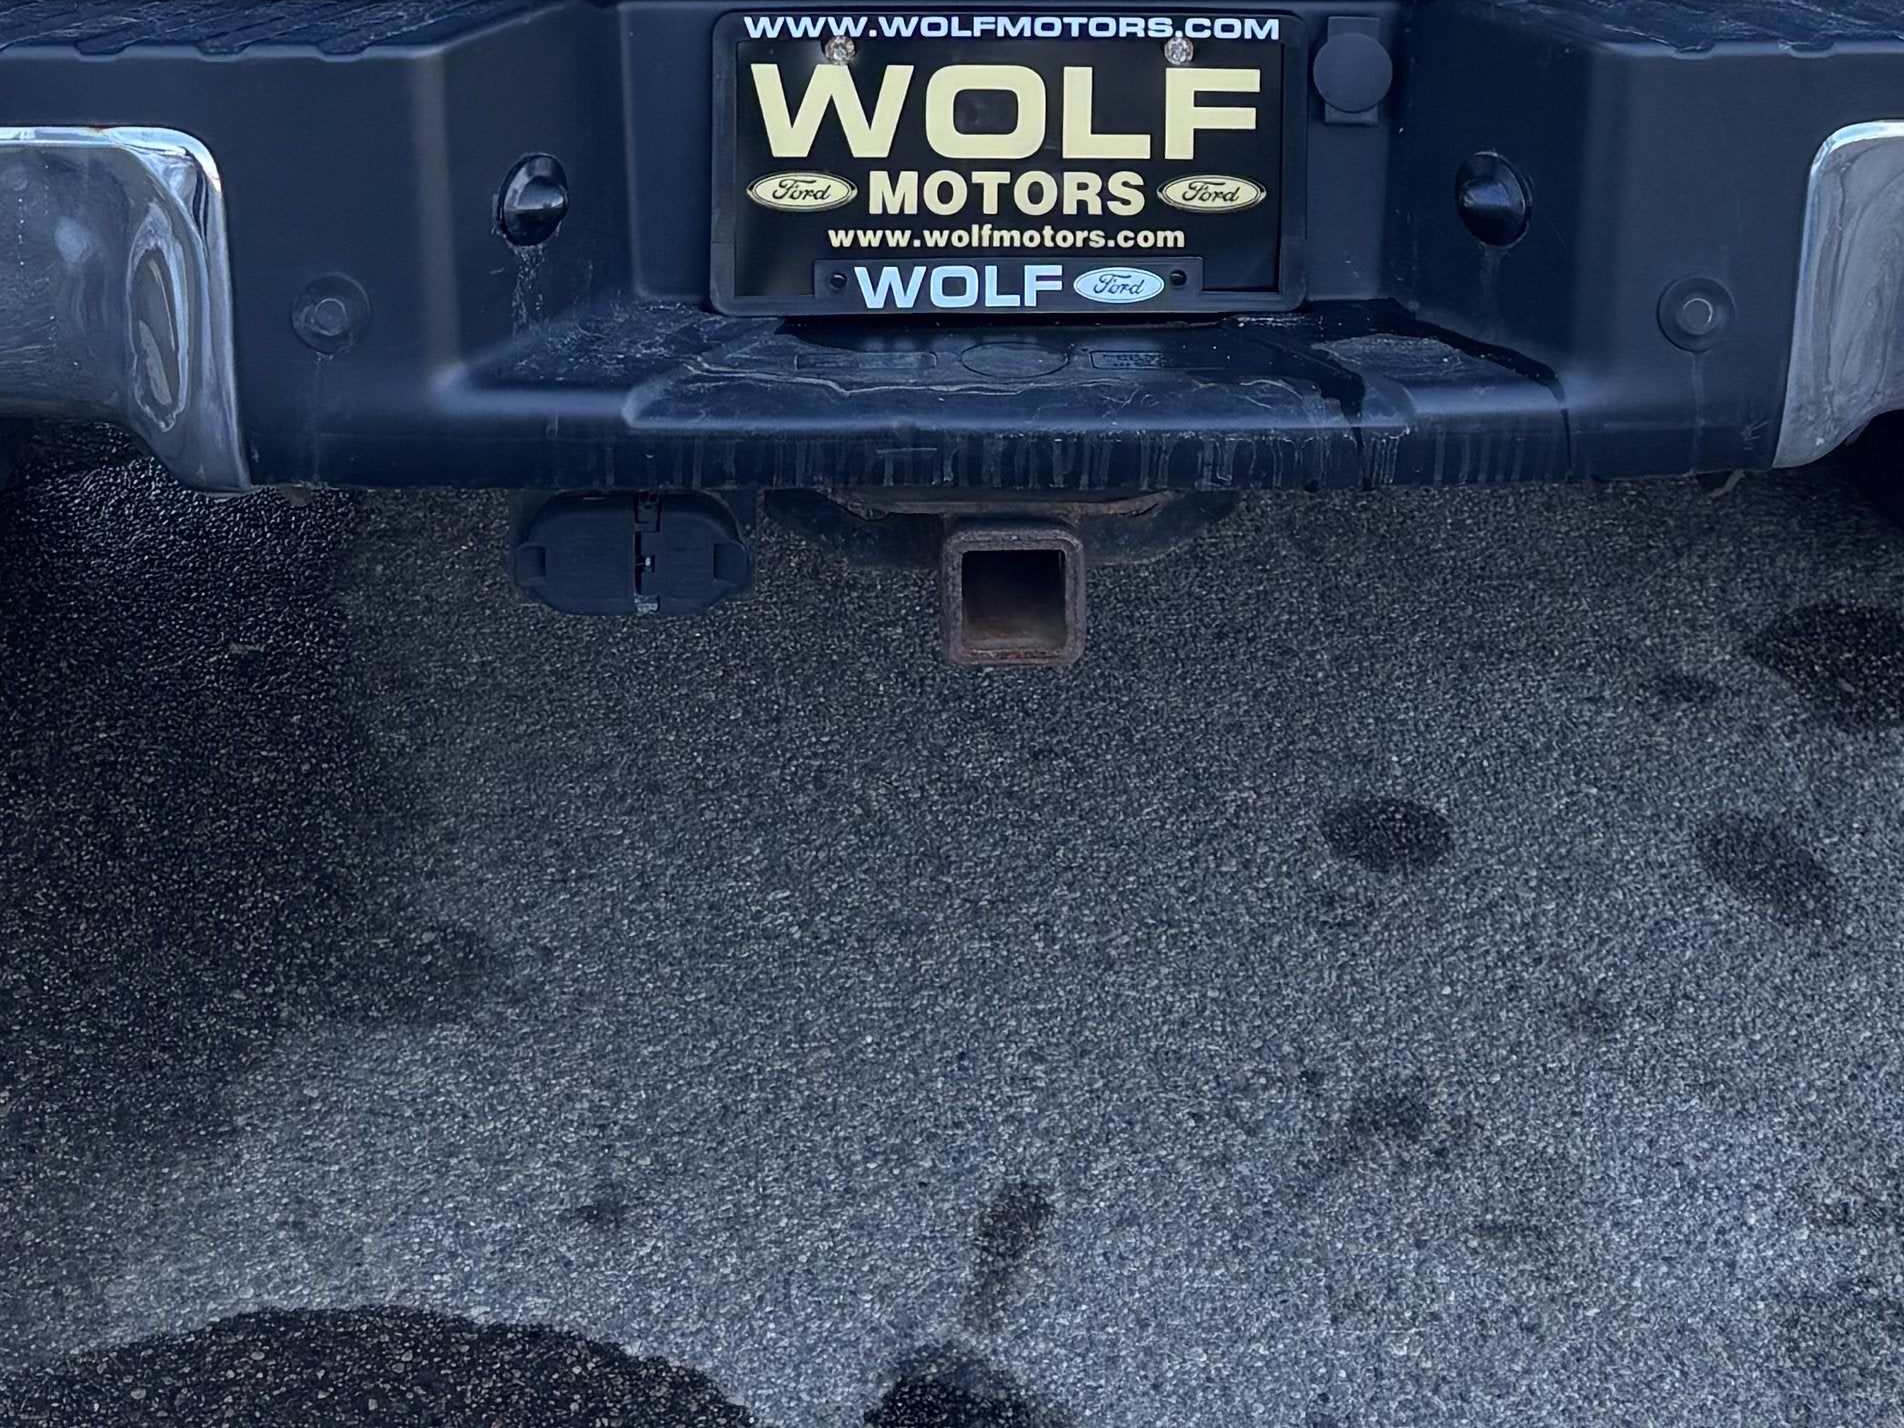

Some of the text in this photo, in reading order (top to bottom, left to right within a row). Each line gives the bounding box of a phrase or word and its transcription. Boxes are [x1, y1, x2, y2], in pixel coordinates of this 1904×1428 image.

[743, 15, 1281, 41] WWW.WOLFMOTORS.COM
[750, 62, 1262, 160] WOLF
[771, 178, 832, 201] Ford
[869, 170, 1146, 217] MOTORS
[1181, 180, 1242, 203] Ford
[827, 223, 1186, 248] www.wolfmotors.com
[853, 264, 1063, 310] WOLF
[1092, 272, 1146, 295] Ford
